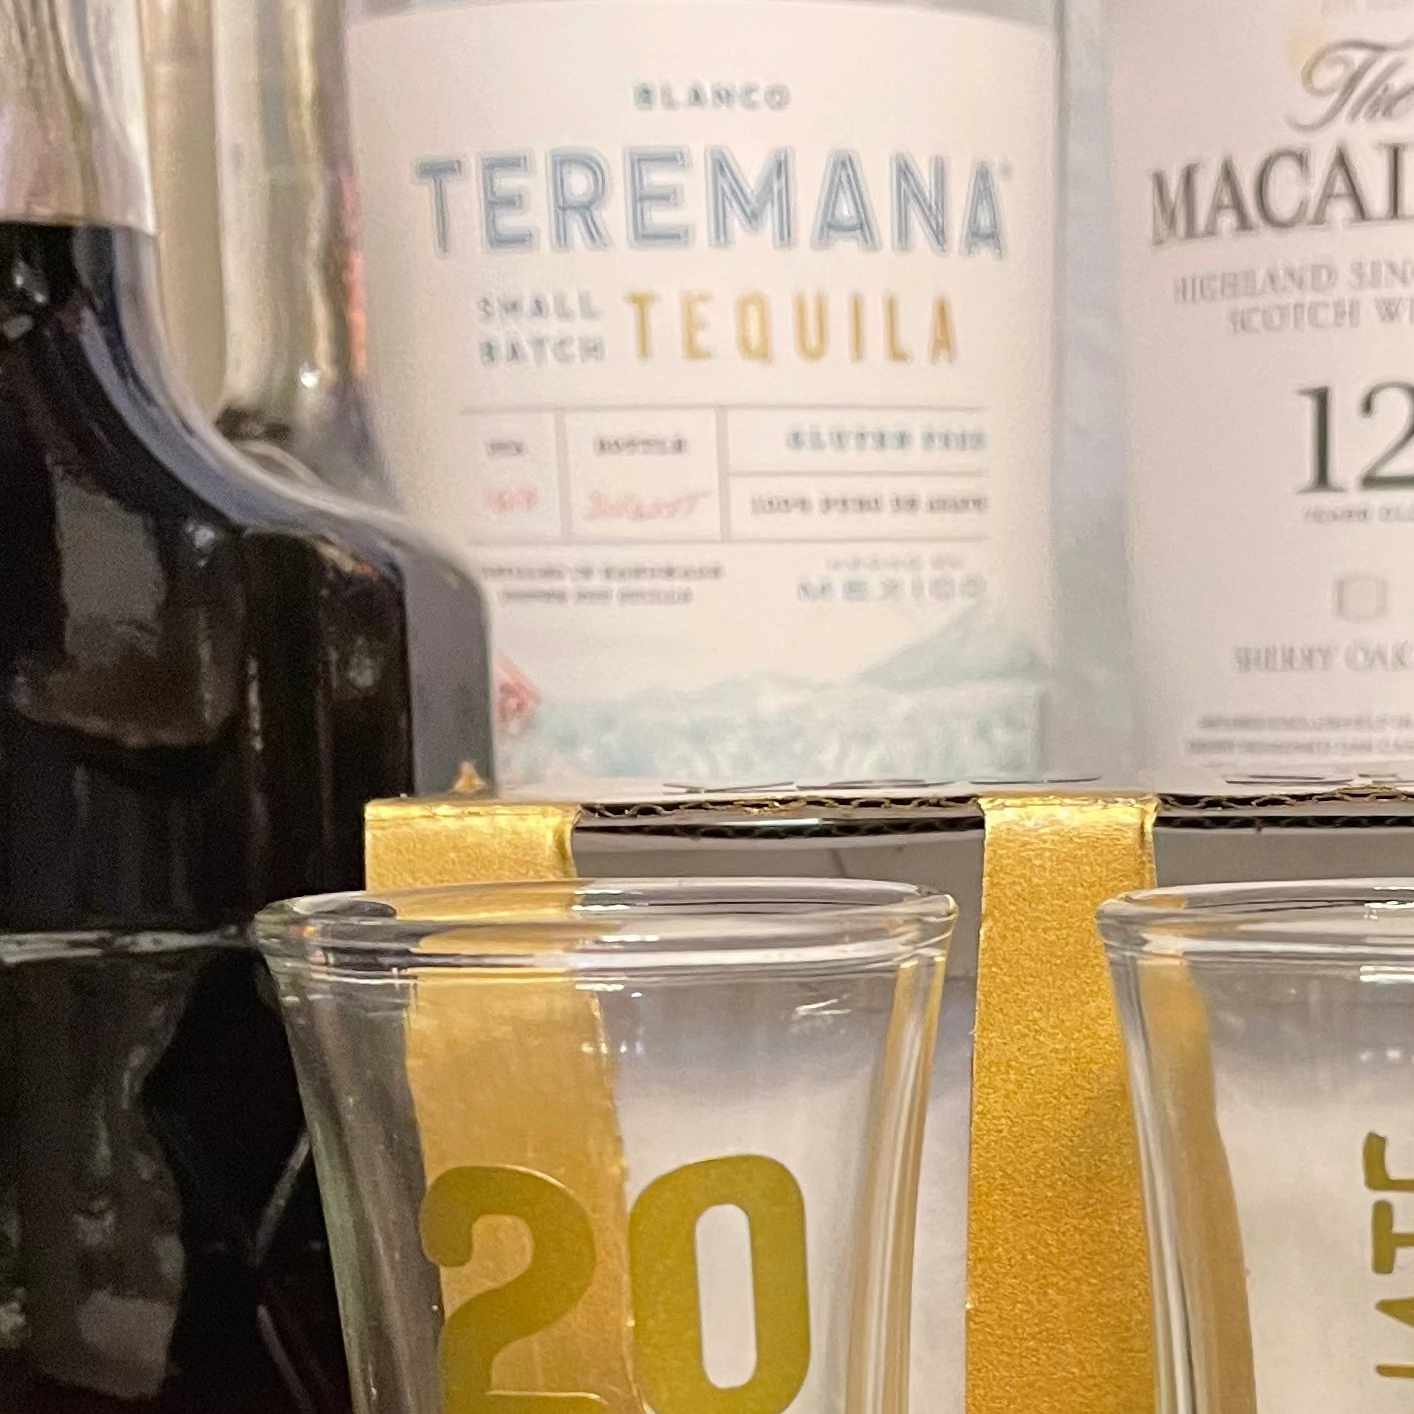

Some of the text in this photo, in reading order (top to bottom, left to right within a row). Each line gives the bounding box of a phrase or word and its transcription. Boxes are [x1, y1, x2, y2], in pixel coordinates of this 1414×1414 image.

[633, 82, 792, 111] BLANCO
[416, 146, 1004, 259] TEREMANA
[477, 292, 603, 322] SMALL
[1229, 297, 1361, 335] SCOTCH
[627, 292, 957, 363] TEQUILA
[479, 336, 606, 366] BATCH
